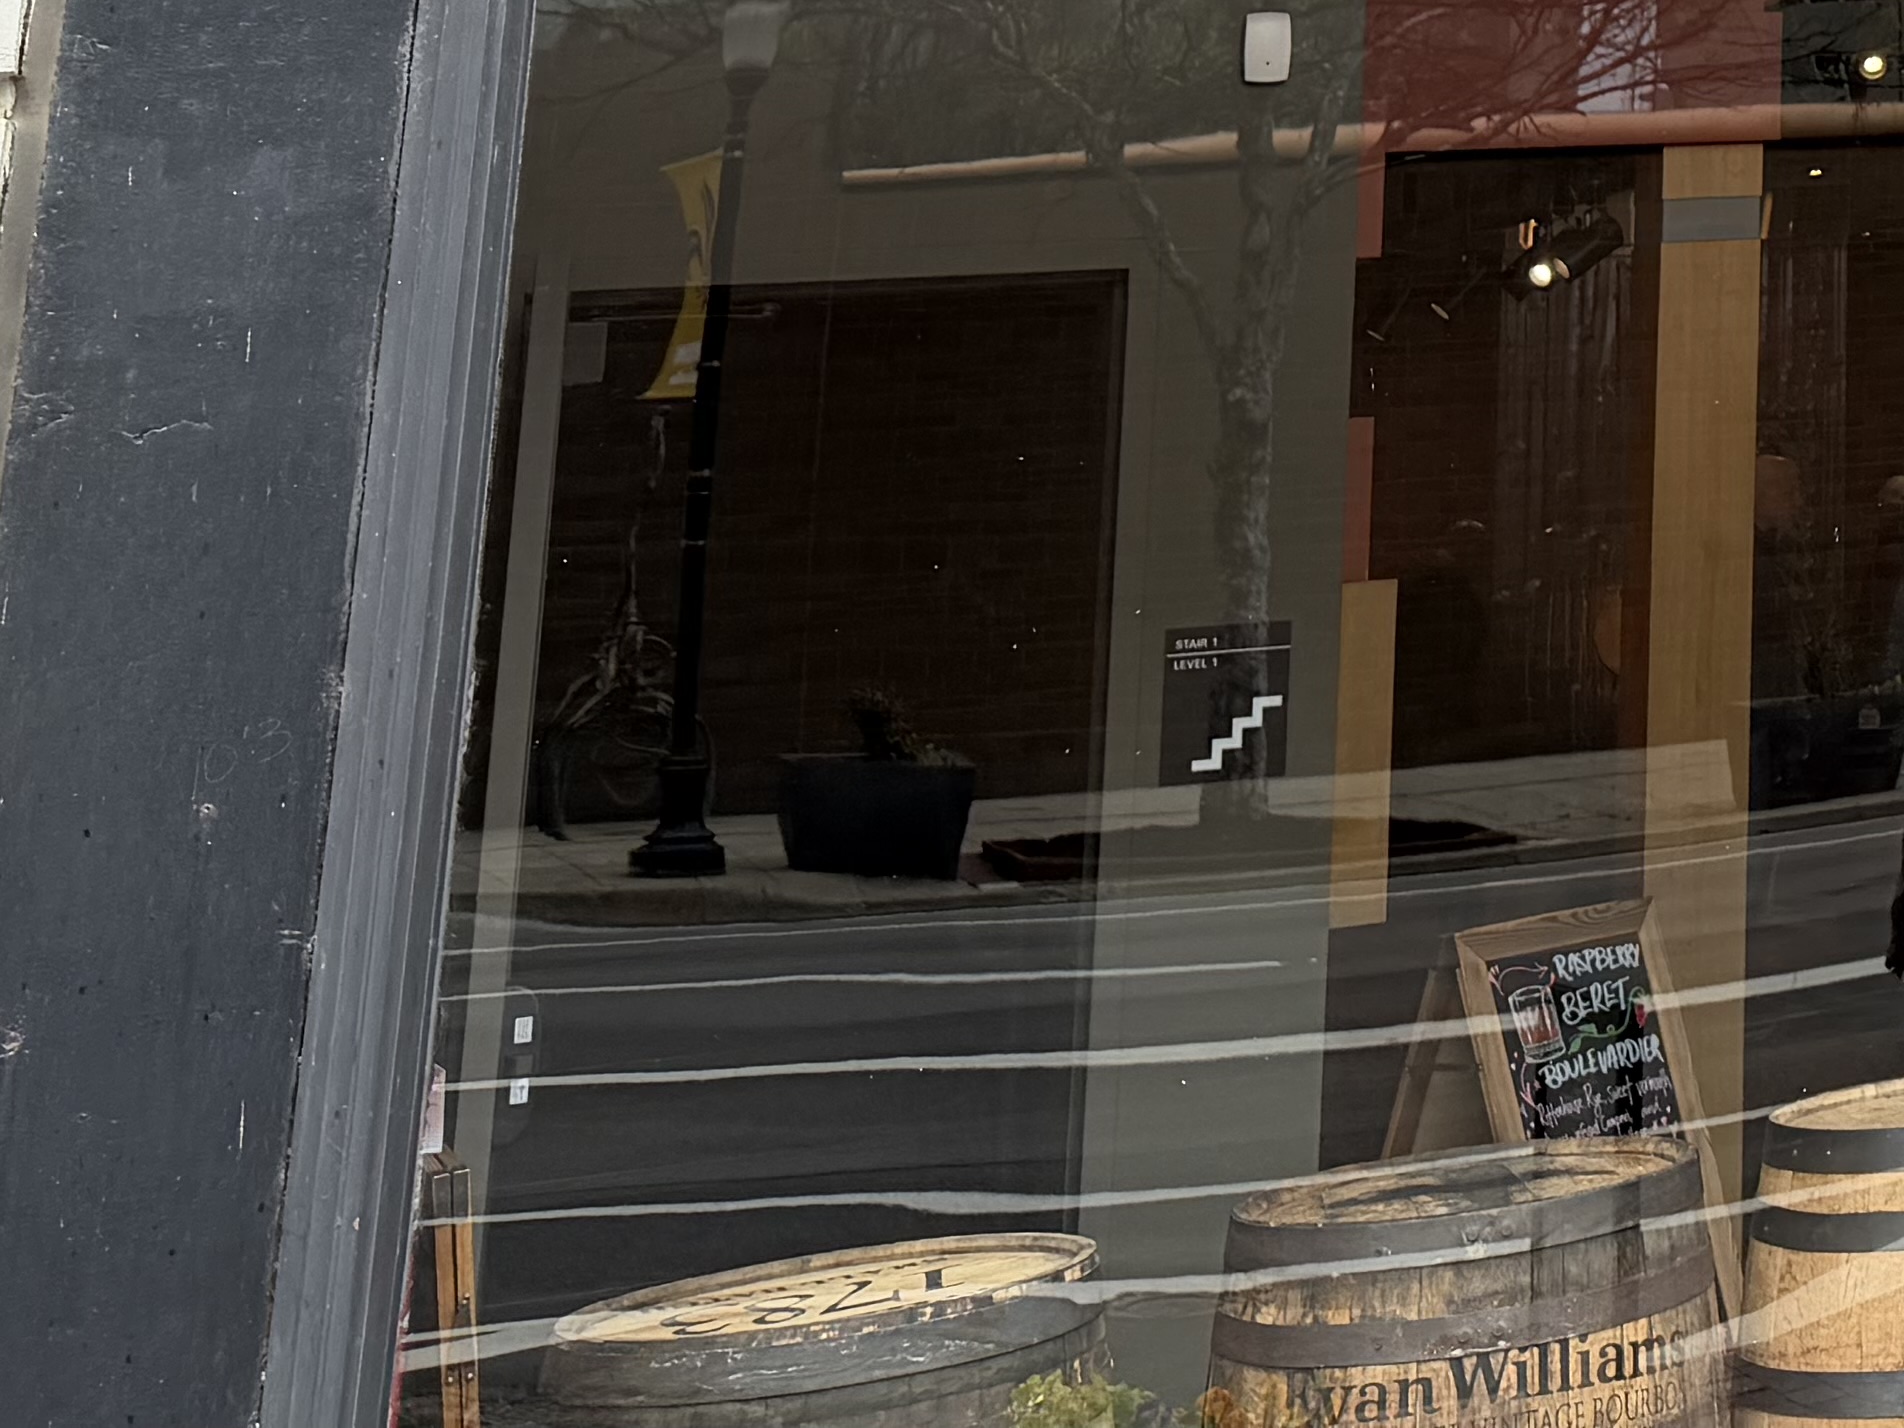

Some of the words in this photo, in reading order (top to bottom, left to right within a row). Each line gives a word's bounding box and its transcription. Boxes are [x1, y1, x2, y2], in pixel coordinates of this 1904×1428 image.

[1173, 658, 1208, 671] LEVEL
[1174, 637, 1208, 650] STAIR
[1552, 942, 1641, 980] RASPBERRY
[1560, 975, 1630, 1026] BERET
[1537, 1032, 1666, 1090] BOULEVARDIER
[1448, 1328, 1686, 1412] Williams
